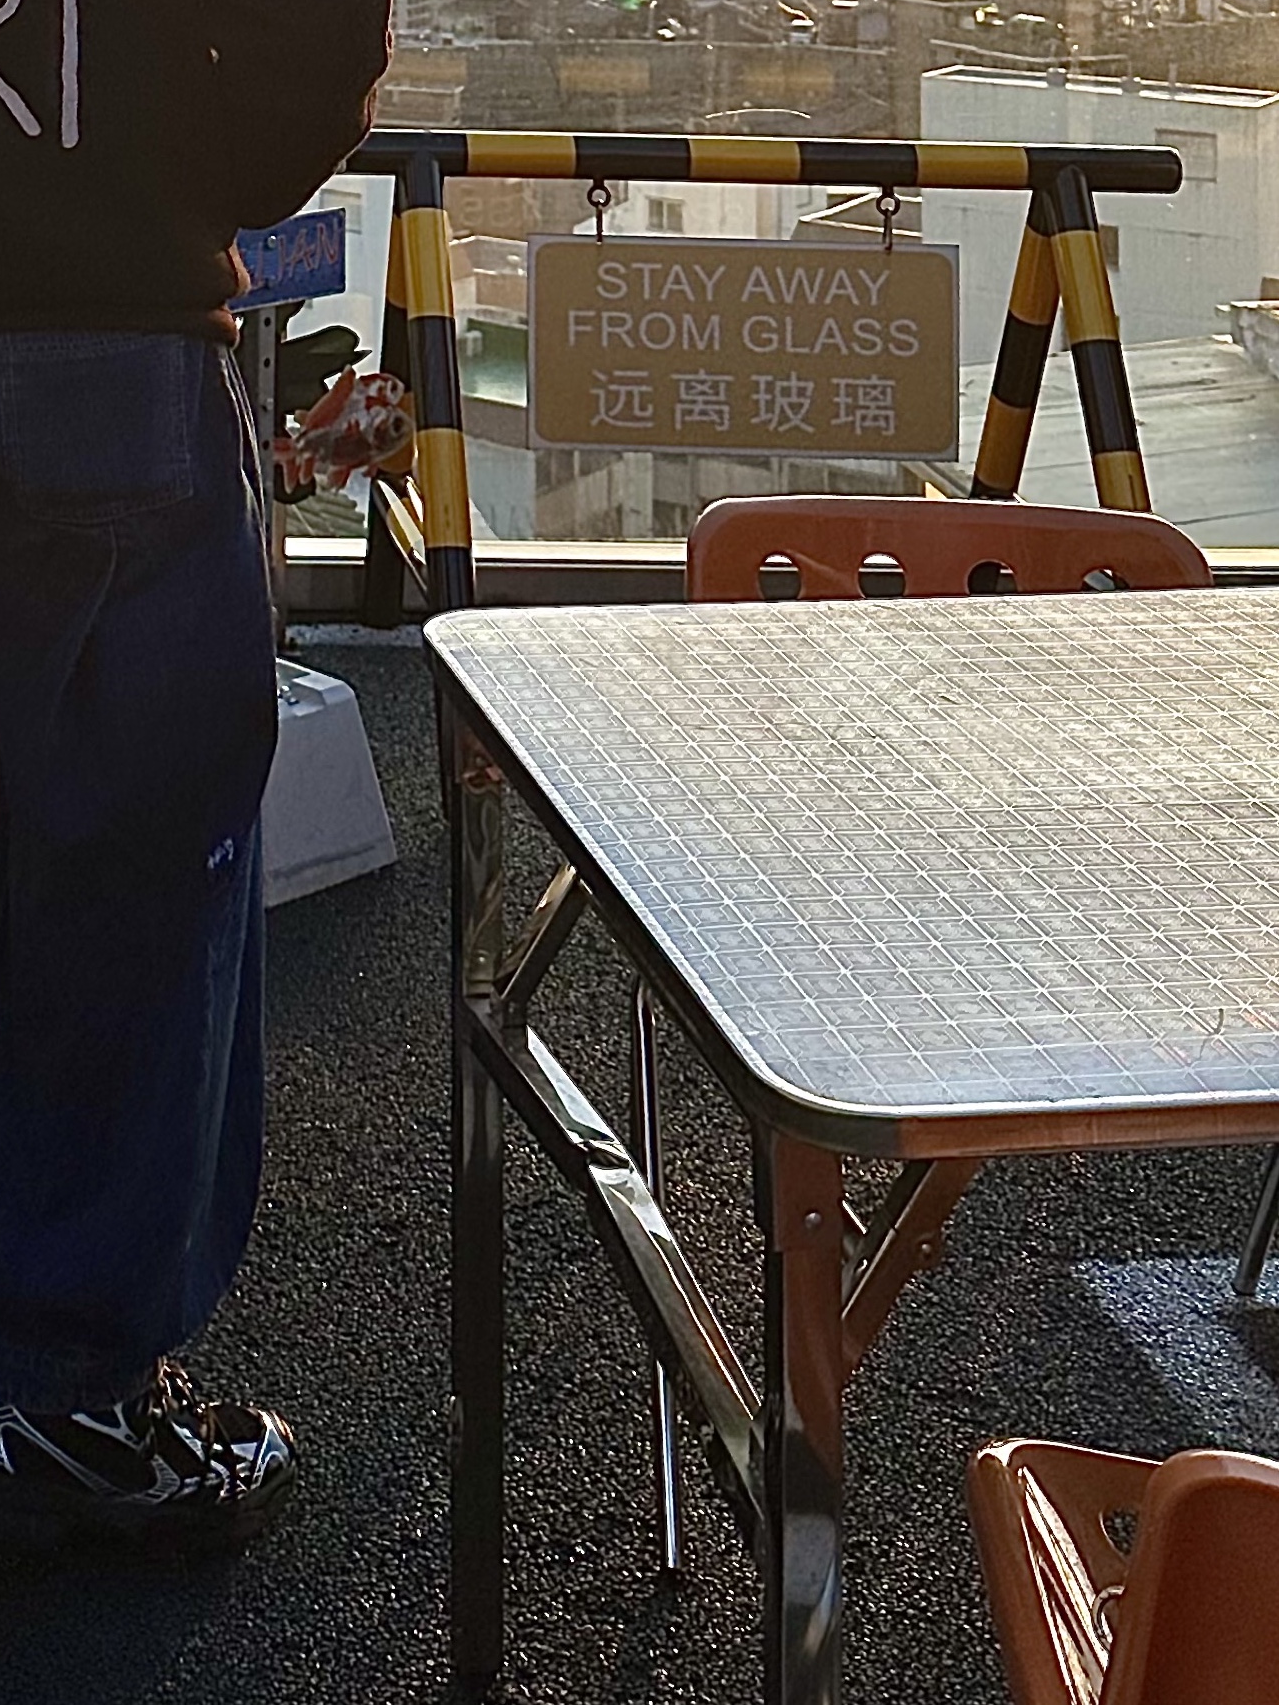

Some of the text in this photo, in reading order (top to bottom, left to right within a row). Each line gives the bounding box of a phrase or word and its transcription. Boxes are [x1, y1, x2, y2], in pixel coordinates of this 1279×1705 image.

[595, 260, 892, 307] STAY AWAY
[566, 309, 920, 358] FROM GLASS
[588, 368, 898, 437] 远离玻璃
